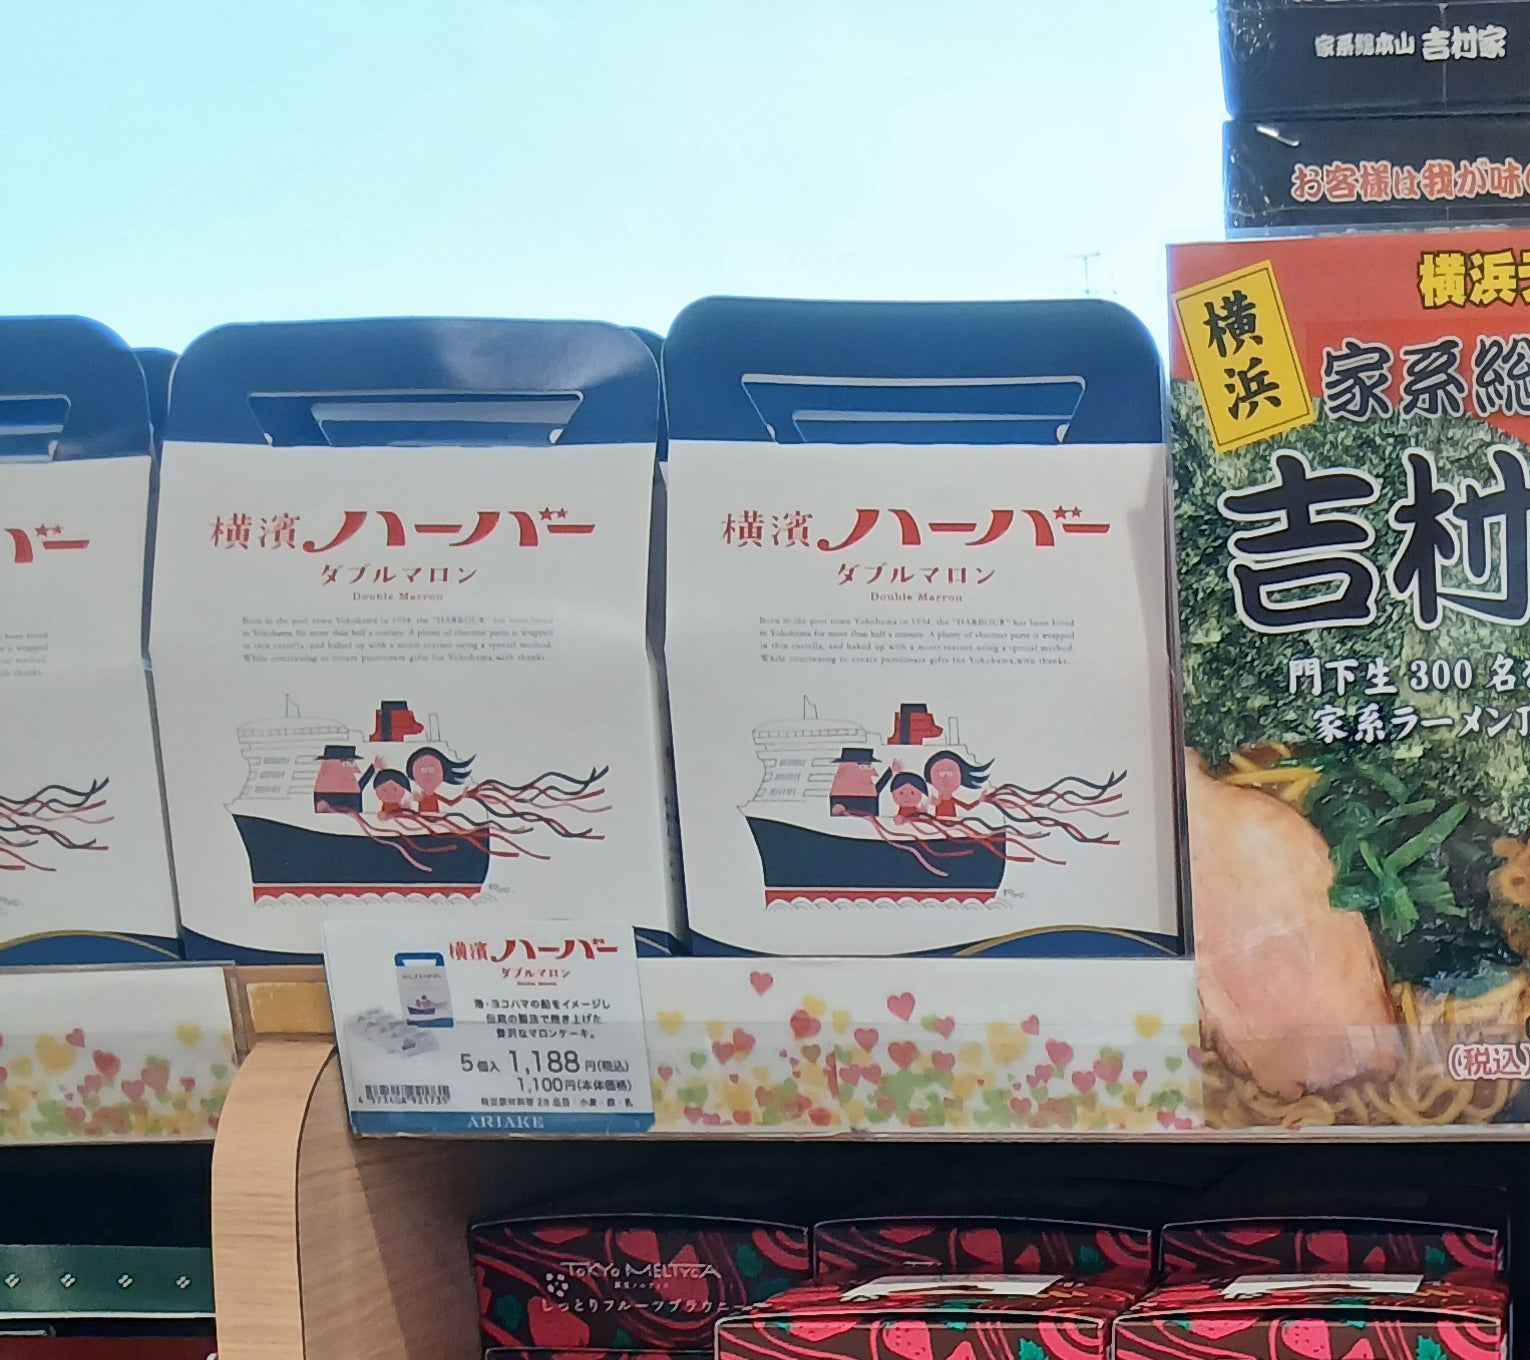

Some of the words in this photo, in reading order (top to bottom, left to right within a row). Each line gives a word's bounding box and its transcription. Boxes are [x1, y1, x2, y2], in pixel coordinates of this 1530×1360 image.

[1421, 25, 1508, 61] 吉村家
[1203, 287, 1284, 421] 横浜
[210, 507, 597, 553] 横濱ハーバー
[721, 505, 1112, 552] 横濱ハーバー
[320, 563, 478, 587] ダブルマロン
[837, 562, 996, 586] ダブルマロン
[870, 592, 913, 602] Double
[1288, 656, 1400, 698] 門下生
[1410, 661, 1473, 692] 300
[449, 938, 618, 964] 横濱ハーバー
[467, 1115, 545, 1129] ARIAKE
